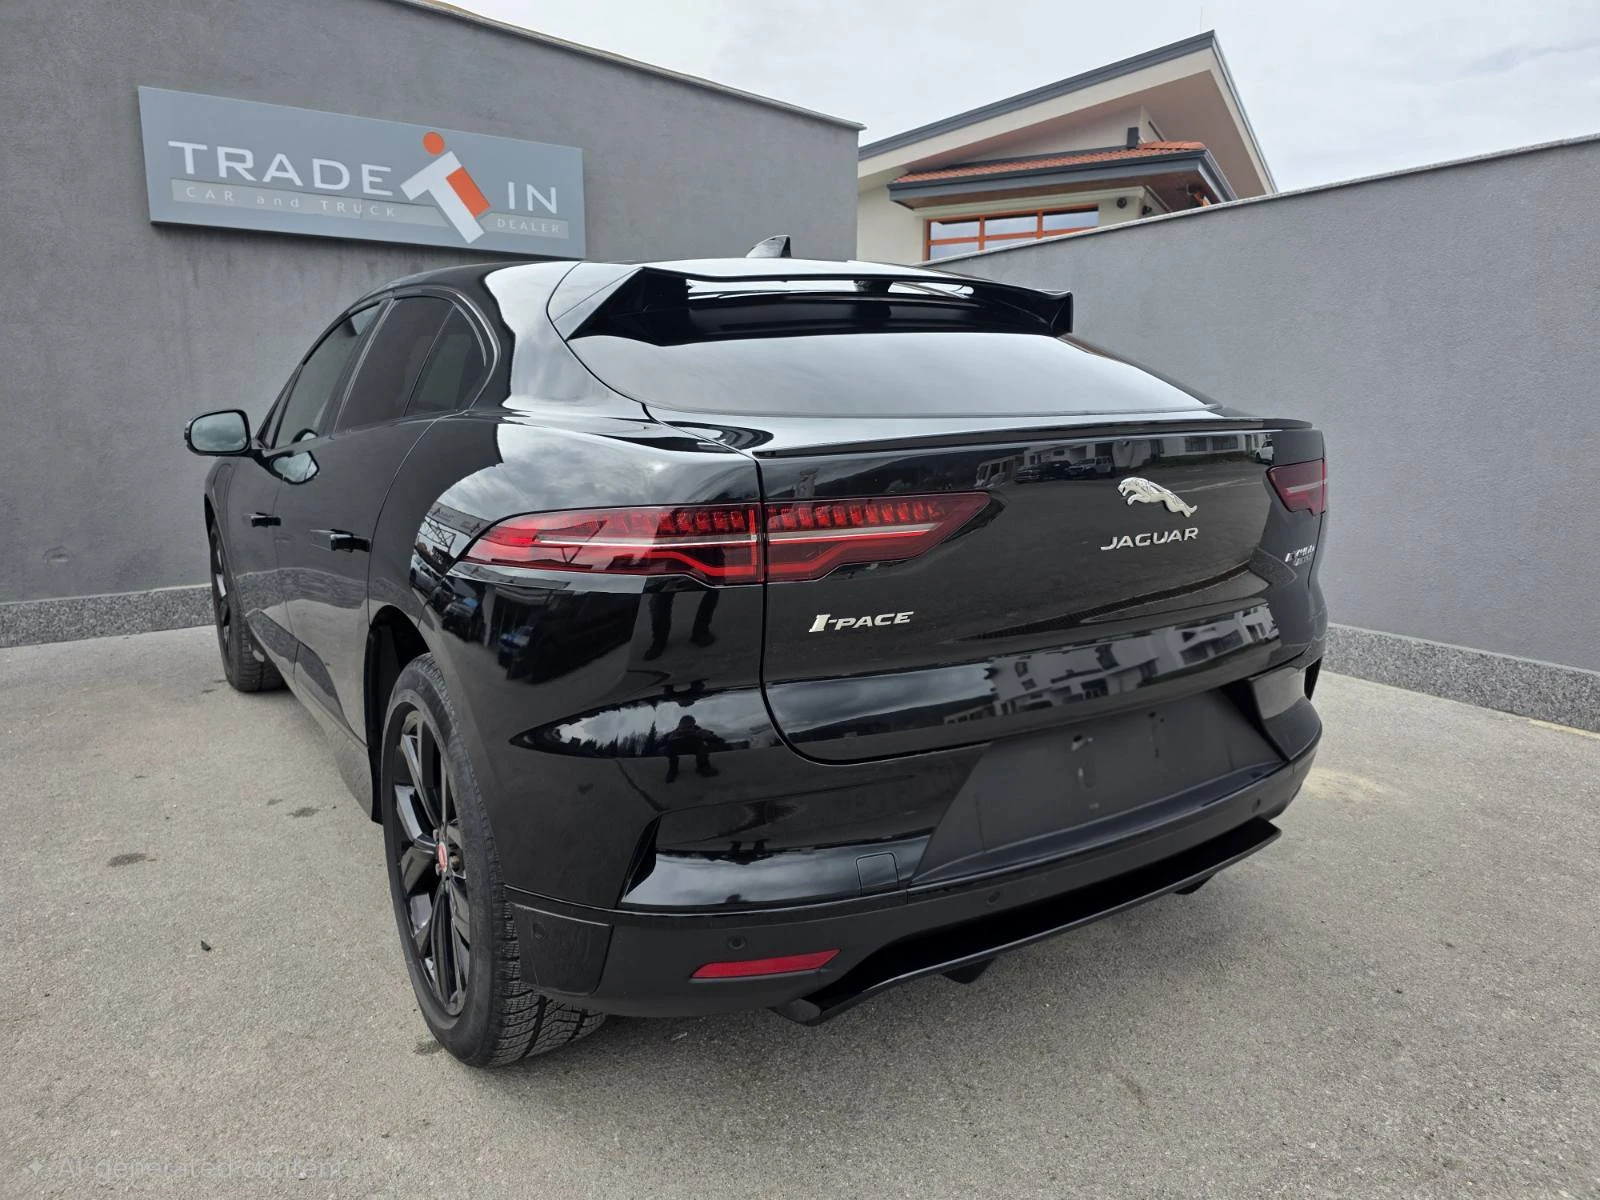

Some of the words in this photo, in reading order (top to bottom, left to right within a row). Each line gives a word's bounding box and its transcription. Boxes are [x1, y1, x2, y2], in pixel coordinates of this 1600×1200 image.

[167, 140, 393, 197] TRADE
[507, 181, 558, 215] IN
[186, 186, 236, 202] CAR
[256, 195, 300, 209] and
[320, 199, 396, 218] TRUCK
[497, 218, 560, 233] DEALER
[1100, 526, 1199, 551] JAGUAR
[808, 610, 915, 634] I-PACE
